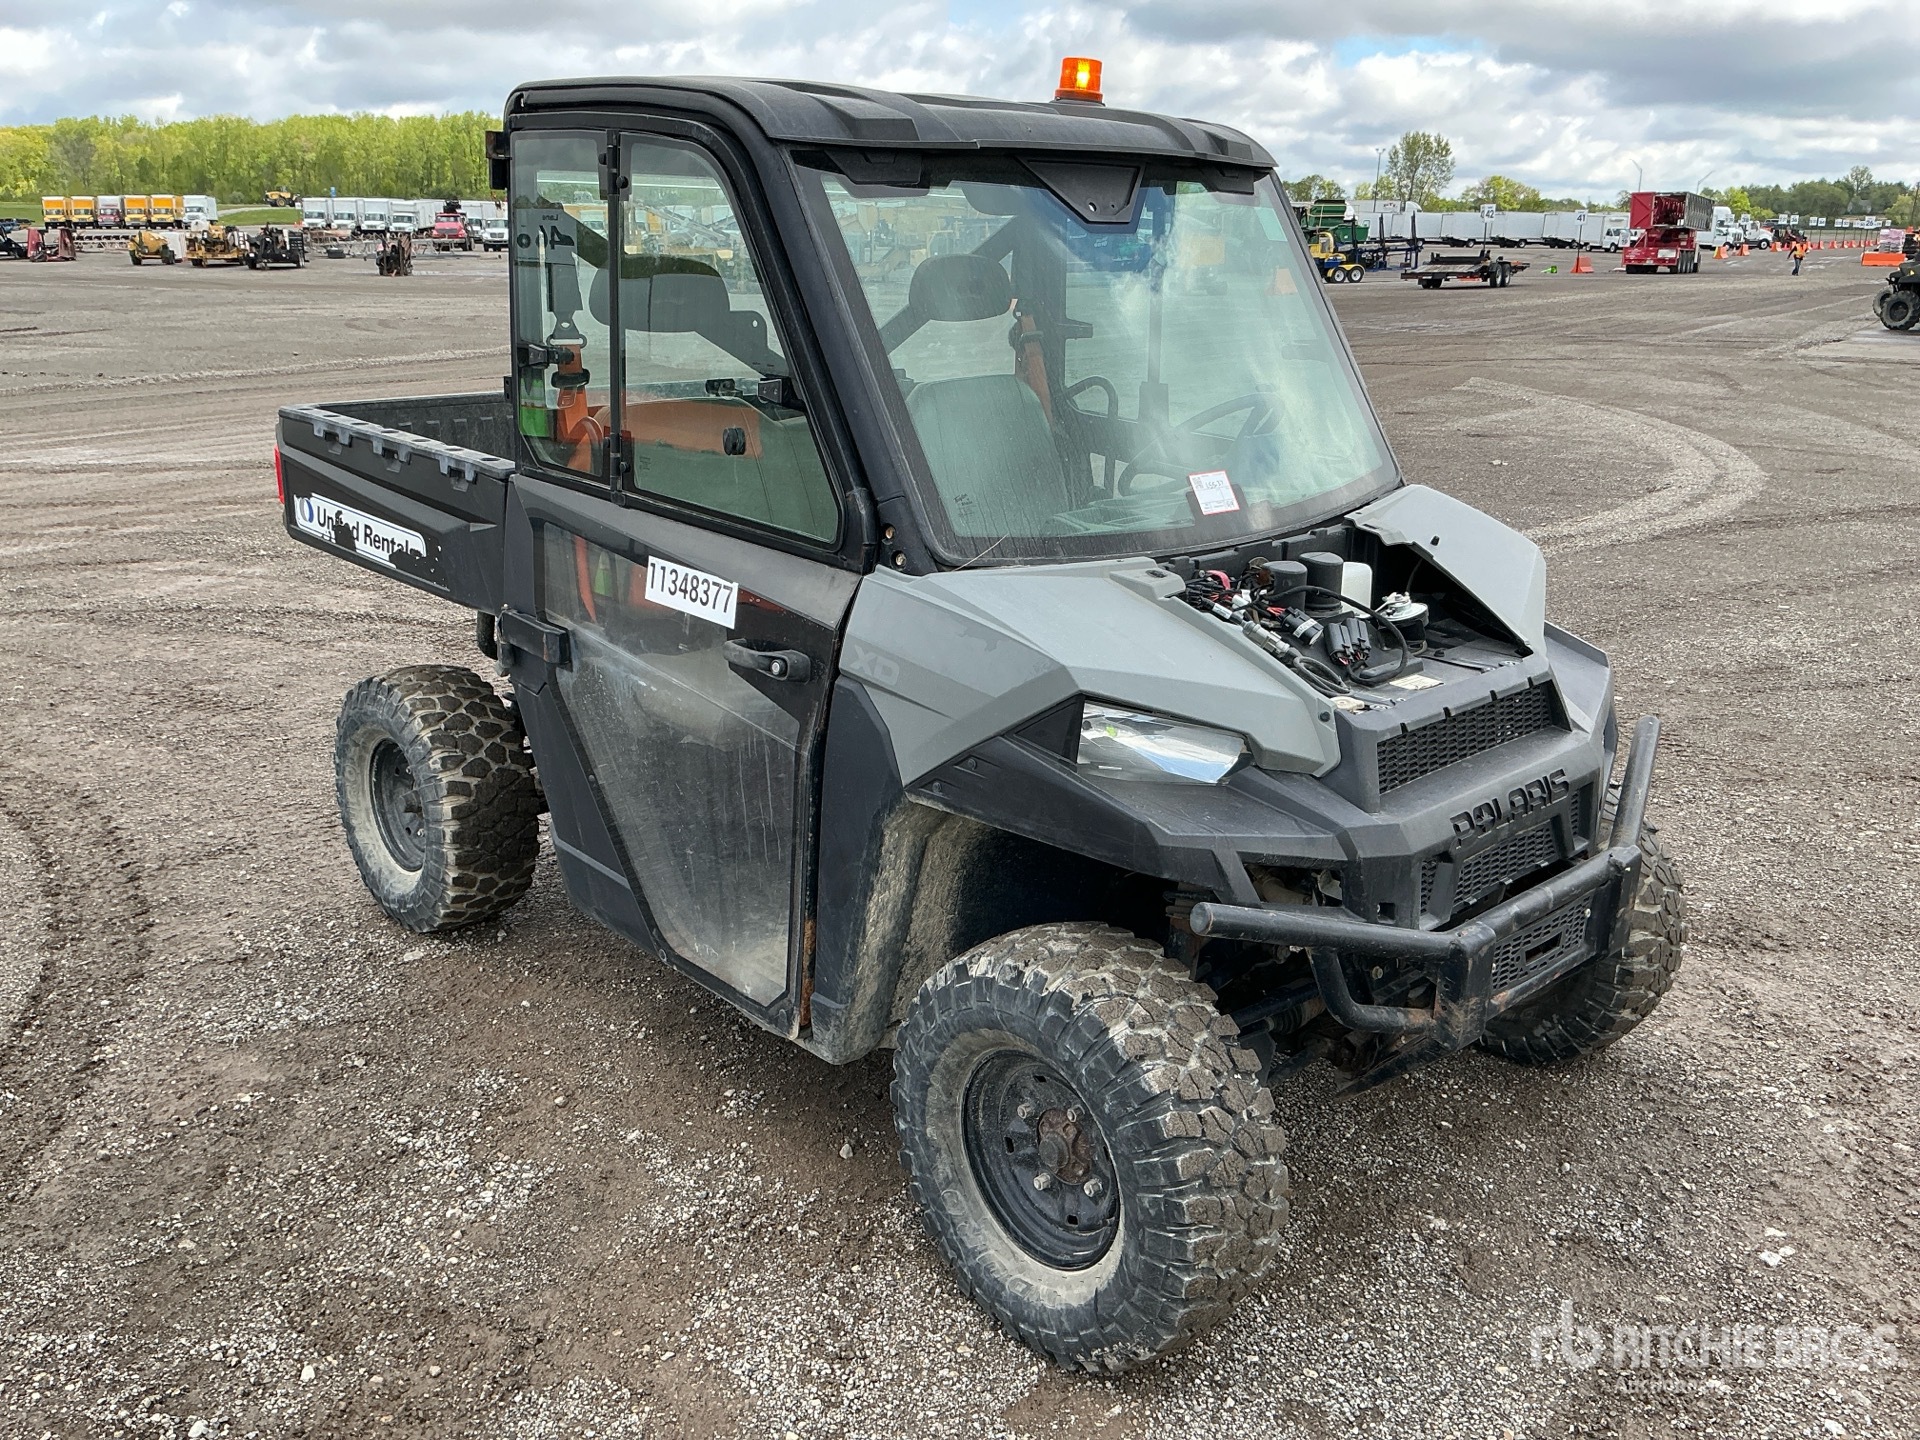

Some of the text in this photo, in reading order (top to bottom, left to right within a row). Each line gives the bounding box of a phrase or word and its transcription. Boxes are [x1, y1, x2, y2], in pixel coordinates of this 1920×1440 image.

[1485, 210, 1494, 219] 42
[1576, 214, 1586, 222] 41
[317, 505, 360, 542] Und
[650, 562, 734, 613] 11348377
[850, 645, 900, 687] XD
[1449, 768, 1570, 848] POLARIS
